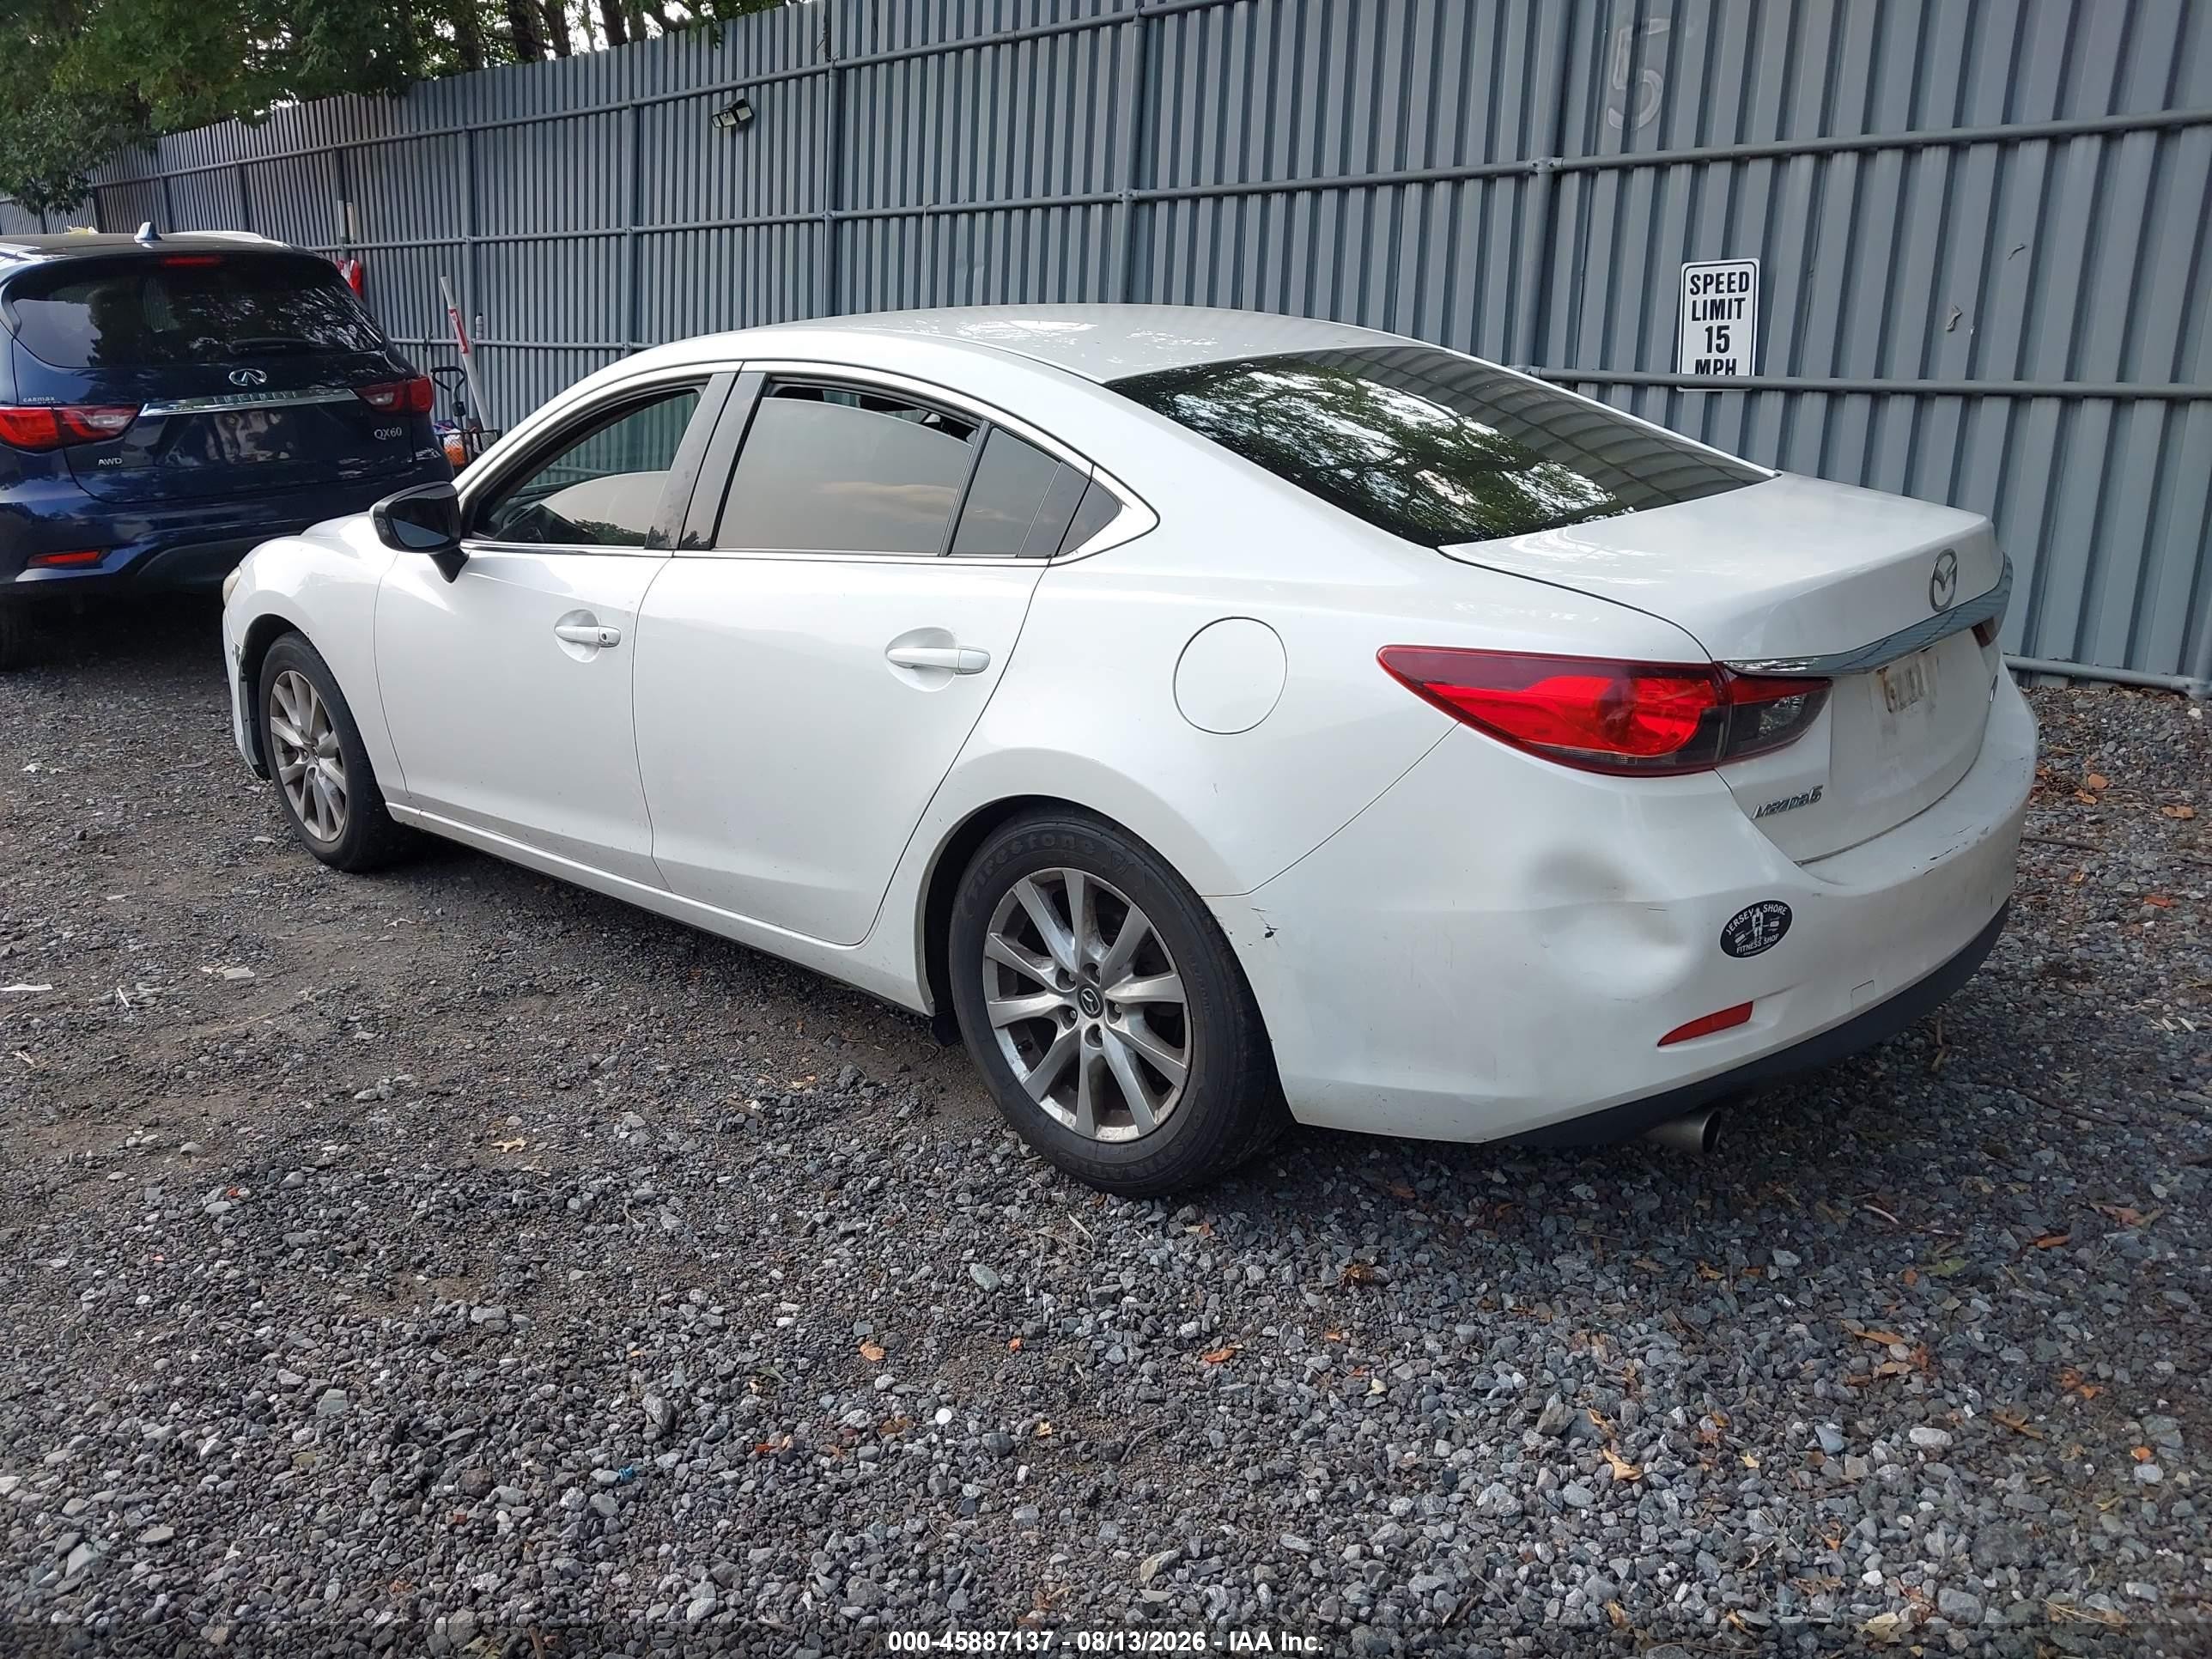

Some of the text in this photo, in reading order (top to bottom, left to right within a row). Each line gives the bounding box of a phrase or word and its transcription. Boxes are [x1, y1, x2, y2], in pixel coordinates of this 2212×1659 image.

[1689, 270, 1750, 295] SPEED
[1691, 297, 1747, 322] LIMIT
[1705, 325, 1730, 354] 15
[1694, 358, 1737, 376] MPH
[374, 427, 402, 441] QX60
[98, 457, 123, 466] AWD
[1725, 903, 1788, 935] JERSEY SHORE
[1736, 939, 1762, 954] FITNESS
[1763, 933, 1779, 945] SHOP
